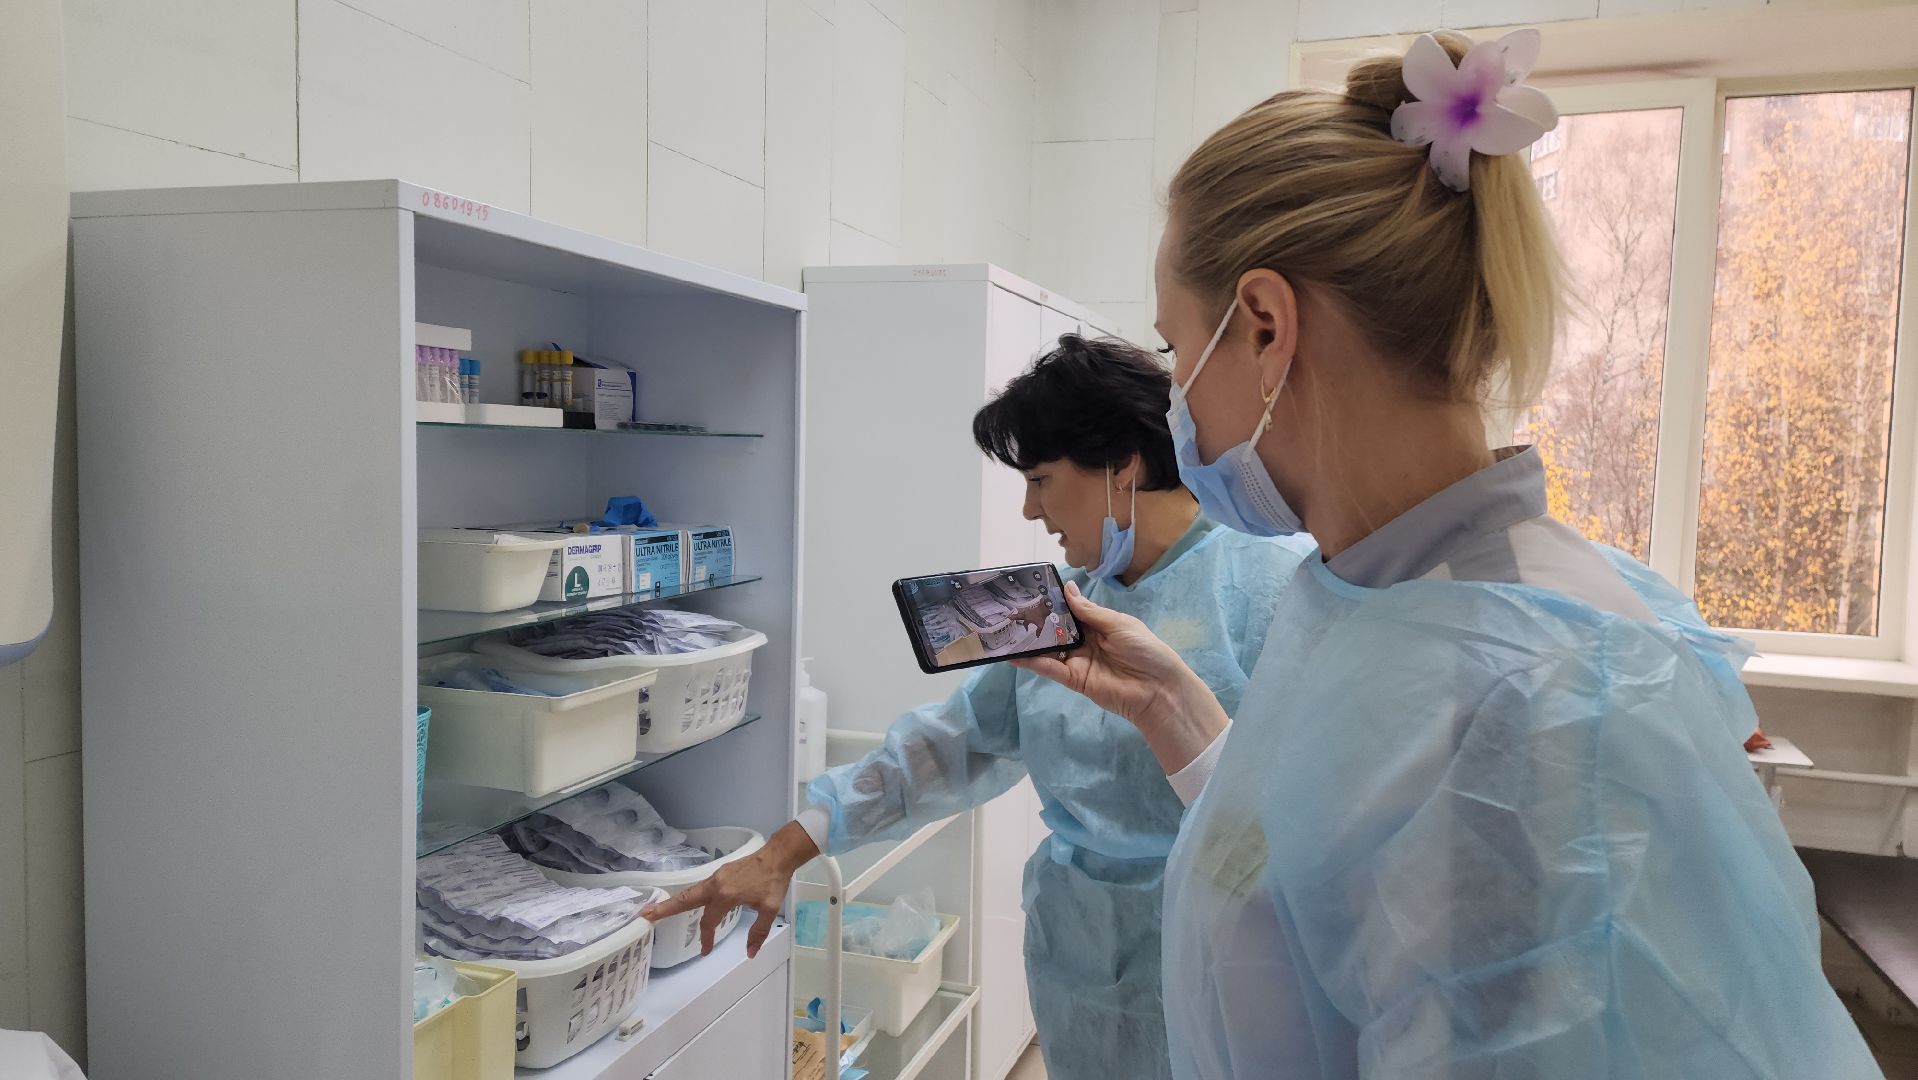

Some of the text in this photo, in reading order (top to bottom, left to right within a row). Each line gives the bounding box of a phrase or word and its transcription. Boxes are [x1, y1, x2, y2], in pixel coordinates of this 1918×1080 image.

[567, 544, 602, 556] DERMAGRIP
[635, 545, 655, 558] ULTRA
[656, 542, 679, 555] NITRILE
[574, 572, 581, 588] L
